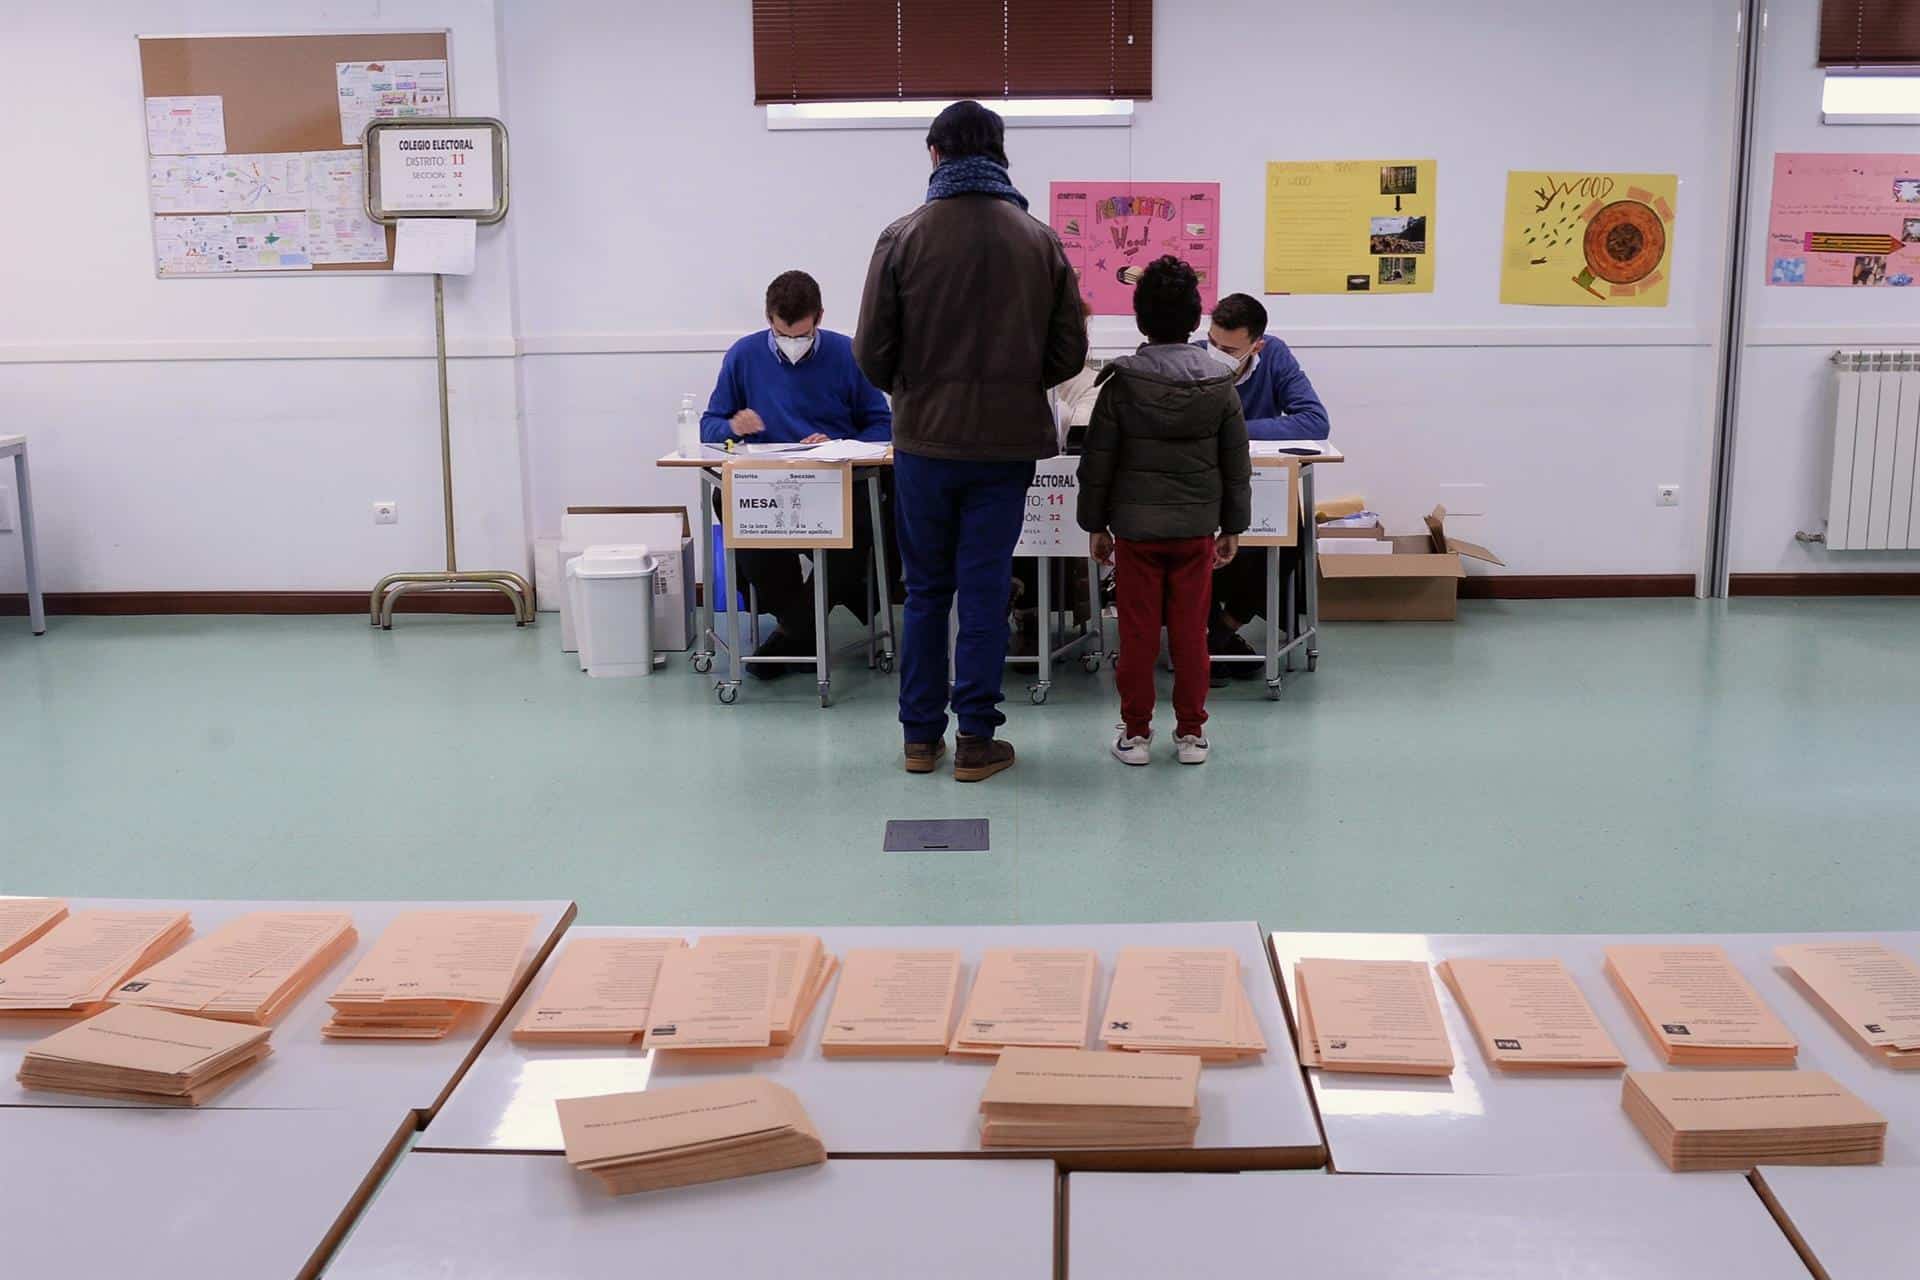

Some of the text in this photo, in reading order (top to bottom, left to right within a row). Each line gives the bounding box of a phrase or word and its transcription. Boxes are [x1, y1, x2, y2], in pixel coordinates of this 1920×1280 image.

[399, 139, 474, 151] COLEGIO ELECTORAL
[452, 154, 465, 165] 11
[1545, 175, 1615, 200] WOOD
[739, 498, 778, 509] MESA
[1047, 494, 1064, 505] 11
